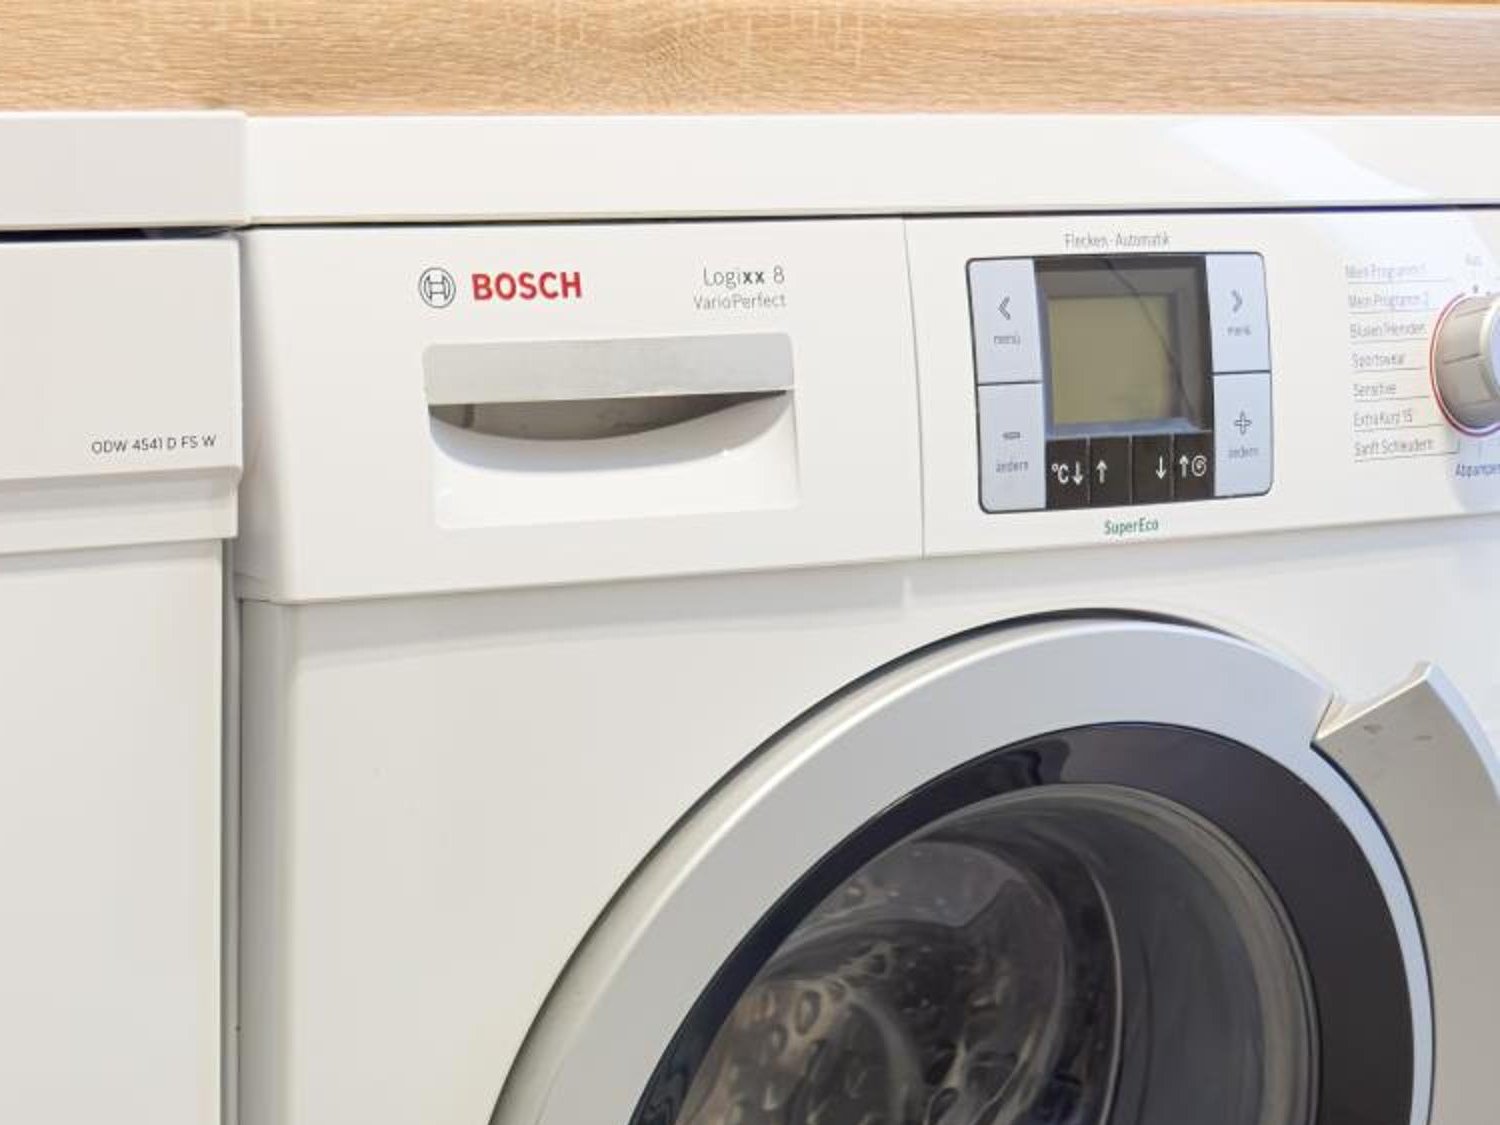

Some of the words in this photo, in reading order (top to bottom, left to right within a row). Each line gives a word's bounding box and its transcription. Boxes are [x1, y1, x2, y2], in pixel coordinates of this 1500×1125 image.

[472, 271, 582, 301] BOSCH
[703, 266, 765, 290] Logixx
[773, 264, 785, 285] 8
[693, 292, 787, 310] VarioPerfect
[91, 438, 128, 456] ODW
[131, 436, 163, 452] 4541
[167, 436, 177, 450] D
[181, 434, 198, 449] FS
[201, 433, 217, 448] W
[1104, 516, 1160, 537] SuperEco
